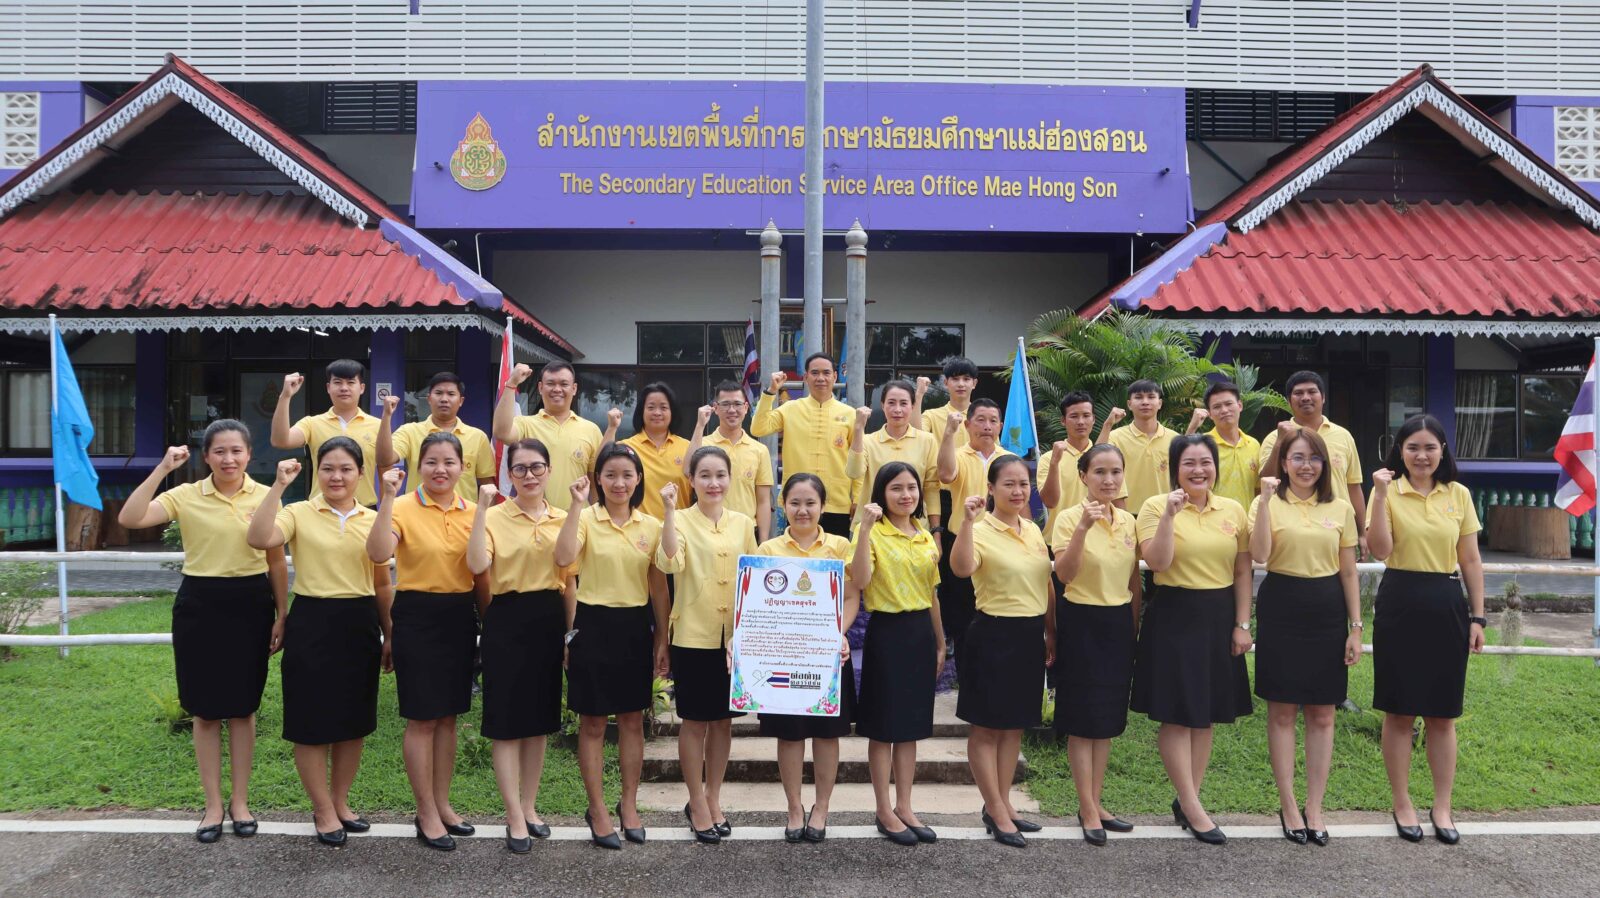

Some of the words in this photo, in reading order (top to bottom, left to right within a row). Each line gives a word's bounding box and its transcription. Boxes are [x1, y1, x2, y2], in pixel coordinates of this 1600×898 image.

[538, 102, 1147, 153] สำนักงานเขตพื้นที่การกษามัธยมศึกษาแม่ฮ่องสอน
[560, 173, 593, 194] The
[599, 173, 695, 199] Secondary
[702, 173, 792, 195] Education
[799, 174, 867, 195] Srvice
[873, 174, 915, 196] Area
[921, 175, 978, 197] Office
[984, 175, 1022, 197] Mae
[1029, 176, 1075, 203] Hong
[1082, 176, 1117, 198] Son
